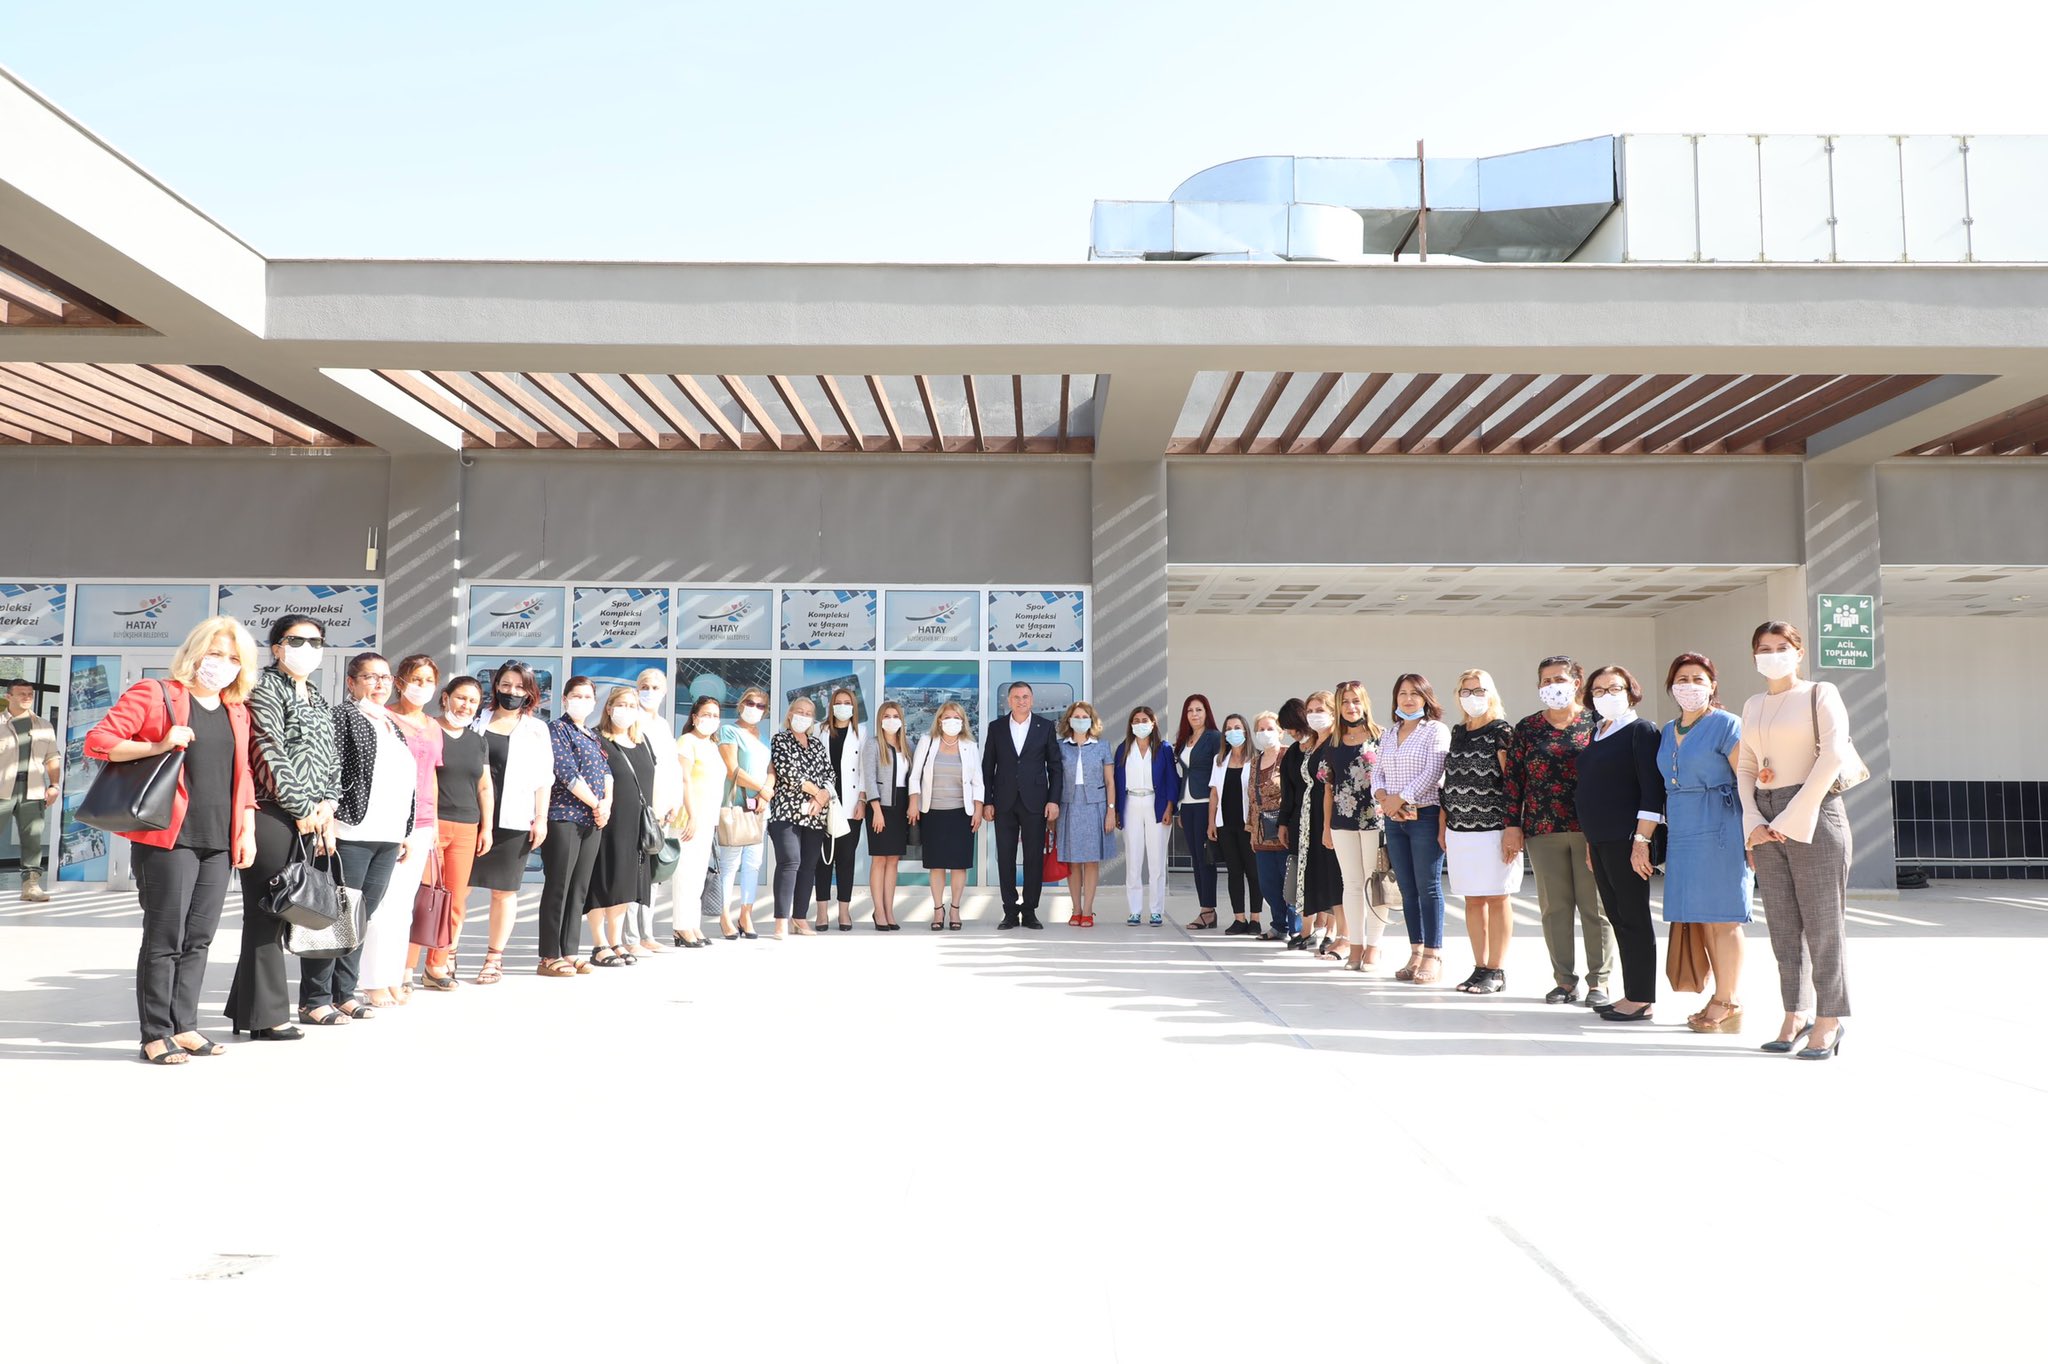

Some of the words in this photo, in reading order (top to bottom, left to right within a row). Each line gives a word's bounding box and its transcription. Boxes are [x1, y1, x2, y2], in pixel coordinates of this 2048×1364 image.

[611, 600, 631, 608] Spor
[819, 602, 839, 610] Spor
[1026, 603, 1046, 611] Spor
[253, 604, 281, 615] Spor
[284, 604, 344, 615] Kompleksi
[599, 609, 643, 618] Kompleksi
[807, 611, 850, 620] Kompleksi
[1014, 612, 1057, 621] Kompleksi
[125, 620, 158, 630] HATAY
[243, 619, 257, 627] ve
[501, 621, 531, 630] HATAY
[612, 619, 641, 628] Yaşam
[820, 621, 849, 630] Yaşam
[1027, 622, 1056, 631] Yaşam
[603, 629, 638, 637] Merkezi
[710, 624, 739, 633] HATAY
[918, 625, 947, 634] HATAY
[811, 630, 846, 638] Merkezi
[1018, 631, 1053, 639] Merkezi
[1837, 640, 1856, 649] ACİL
[1825, 649, 1869, 658] TOPLANMA
[1837, 658, 1856, 666] YERİ
